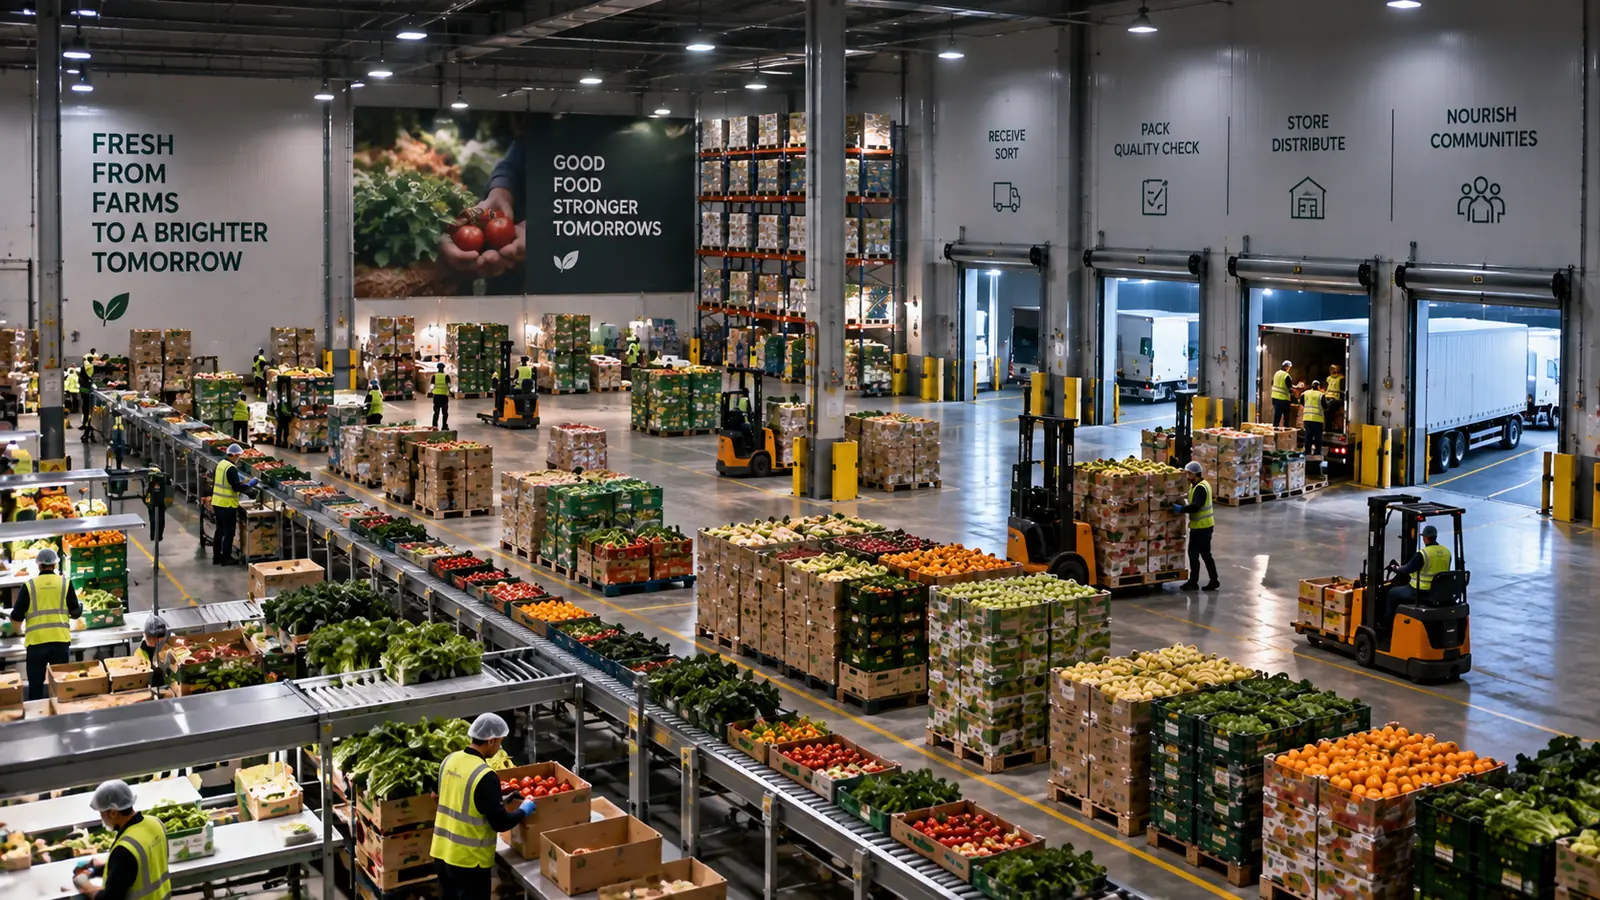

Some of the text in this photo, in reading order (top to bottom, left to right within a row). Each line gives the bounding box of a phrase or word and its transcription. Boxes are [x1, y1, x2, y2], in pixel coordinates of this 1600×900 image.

[1287, 114, 1329, 130] STORE
[1447, 107, 1517, 125] NOURISH
[988, 129, 1026, 143] RECEIVE
[1141, 122, 1170, 136] PACK
[93, 133, 174, 156] FRESH
[1272, 136, 1346, 152] DISTRIBUTE
[1430, 130, 1538, 149] COMMUNITIES
[995, 147, 1019, 160] SORT
[1114, 141, 1200, 158] QUALITY CHECK
[553, 154, 605, 172] GOOD
[92, 162, 166, 184] FROM
[553, 176, 602, 193] FOOD
[92, 191, 179, 214] FARMS
[553, 198, 638, 215] STRONGER
[92, 221, 268, 243] TO A BRIGHTER
[552, 220, 662, 237] TOMORROWS
[92, 250, 243, 273] TOMORROW
